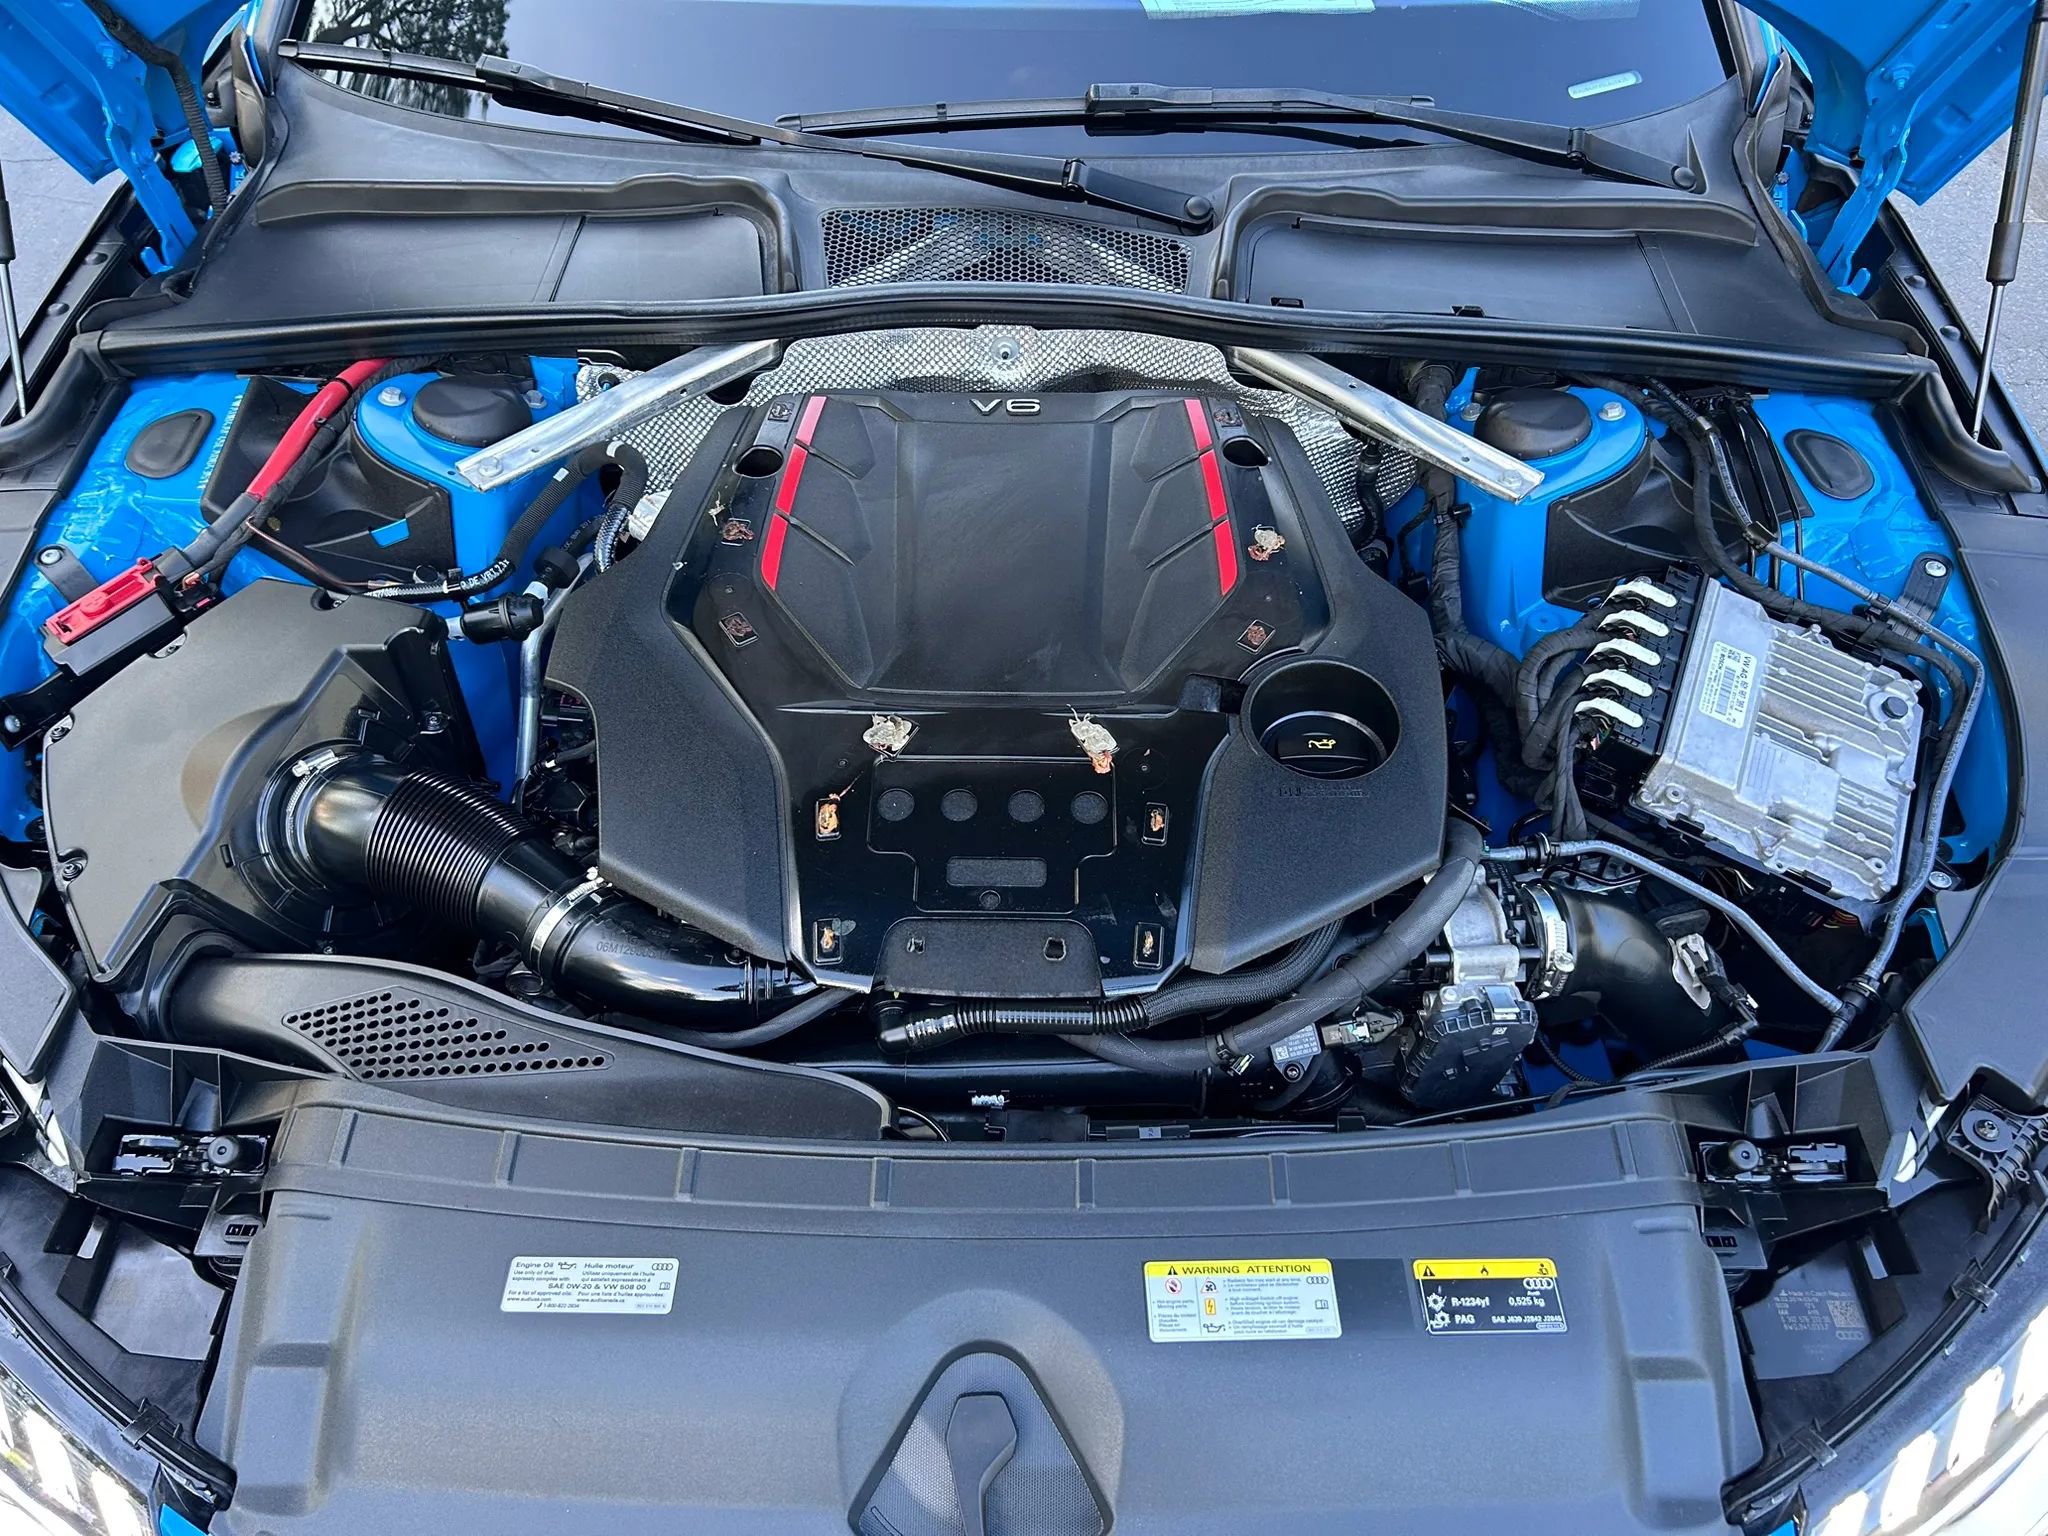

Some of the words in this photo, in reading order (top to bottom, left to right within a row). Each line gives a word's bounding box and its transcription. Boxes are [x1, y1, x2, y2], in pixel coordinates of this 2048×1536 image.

[969, 398, 1041, 414] V6
[1182, 1265, 1240, 1275] WARNING
[1247, 1264, 1312, 1274] ATTENTION
[1508, 1296, 1532, 1307] 0,525
[1533, 1296, 1545, 1307] kg
[1454, 1314, 1476, 1325] PAG
